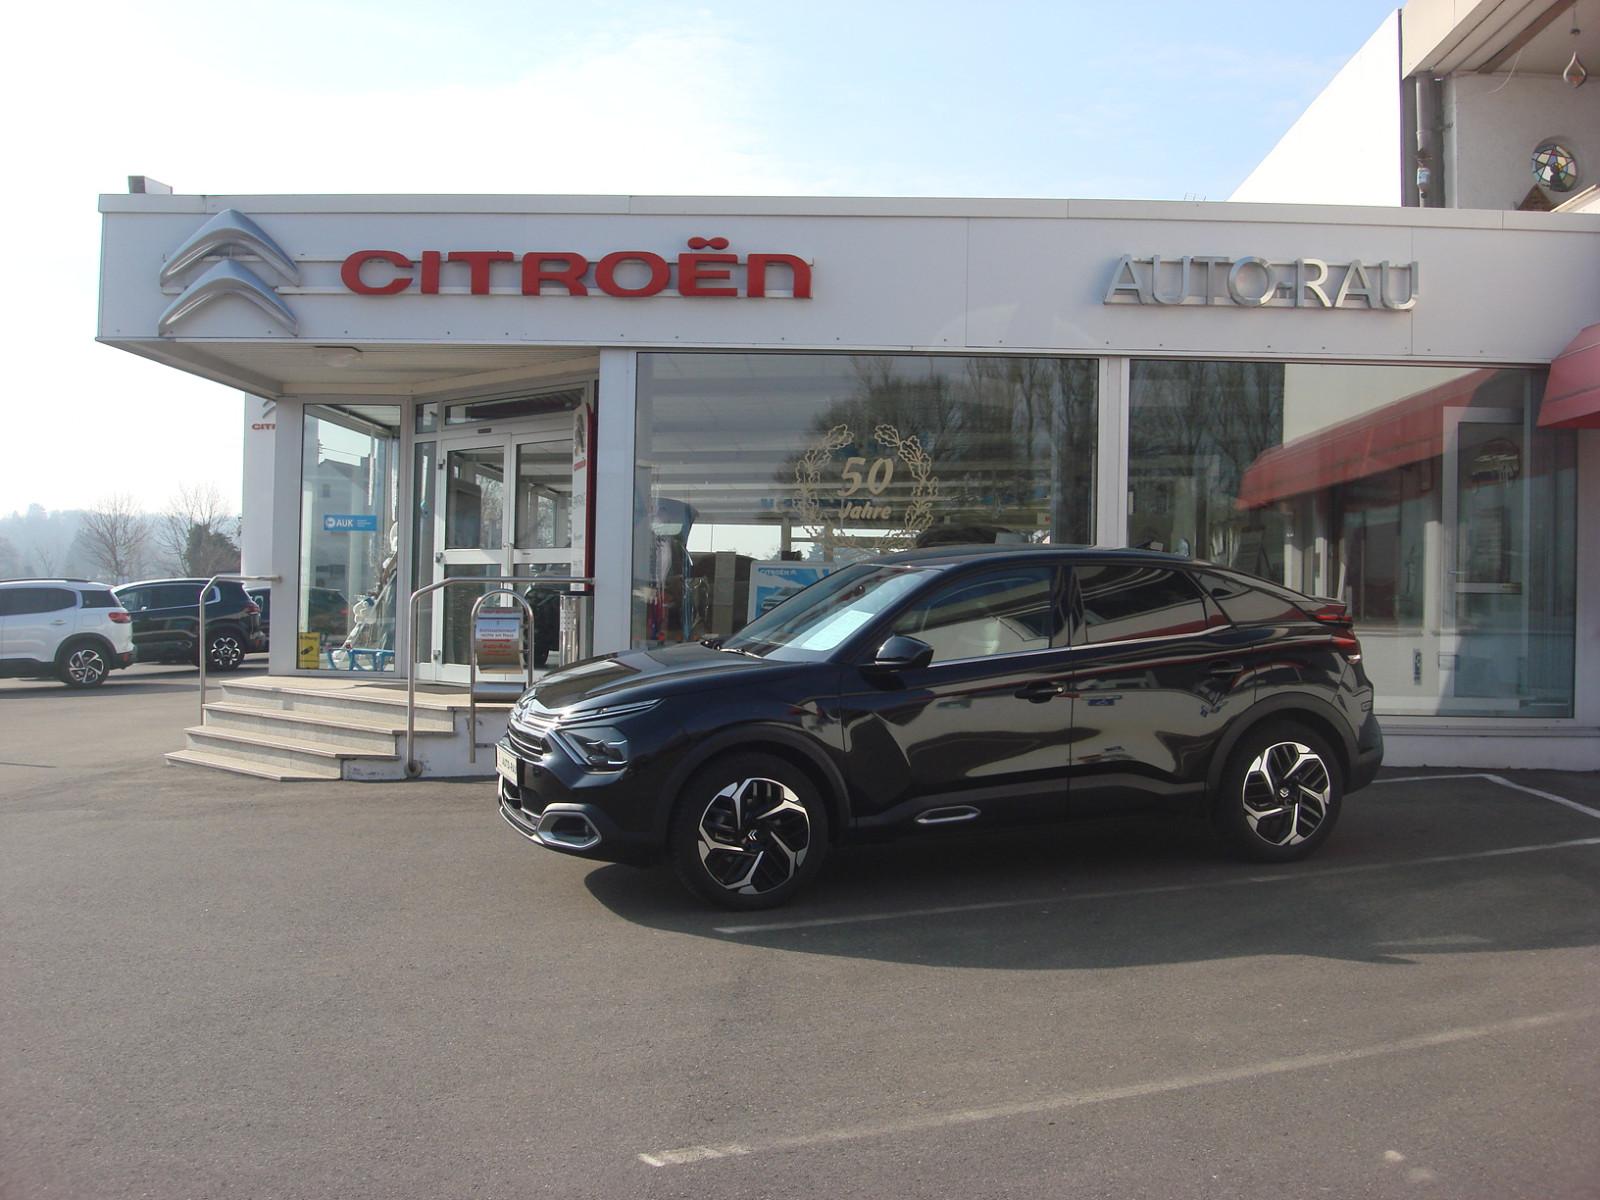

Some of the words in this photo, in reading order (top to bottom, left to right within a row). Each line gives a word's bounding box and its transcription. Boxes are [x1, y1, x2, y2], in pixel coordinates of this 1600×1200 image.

[340, 237, 813, 299] CITROËN
[837, 457, 894, 497] 50
[838, 501, 892, 520] Jahre
